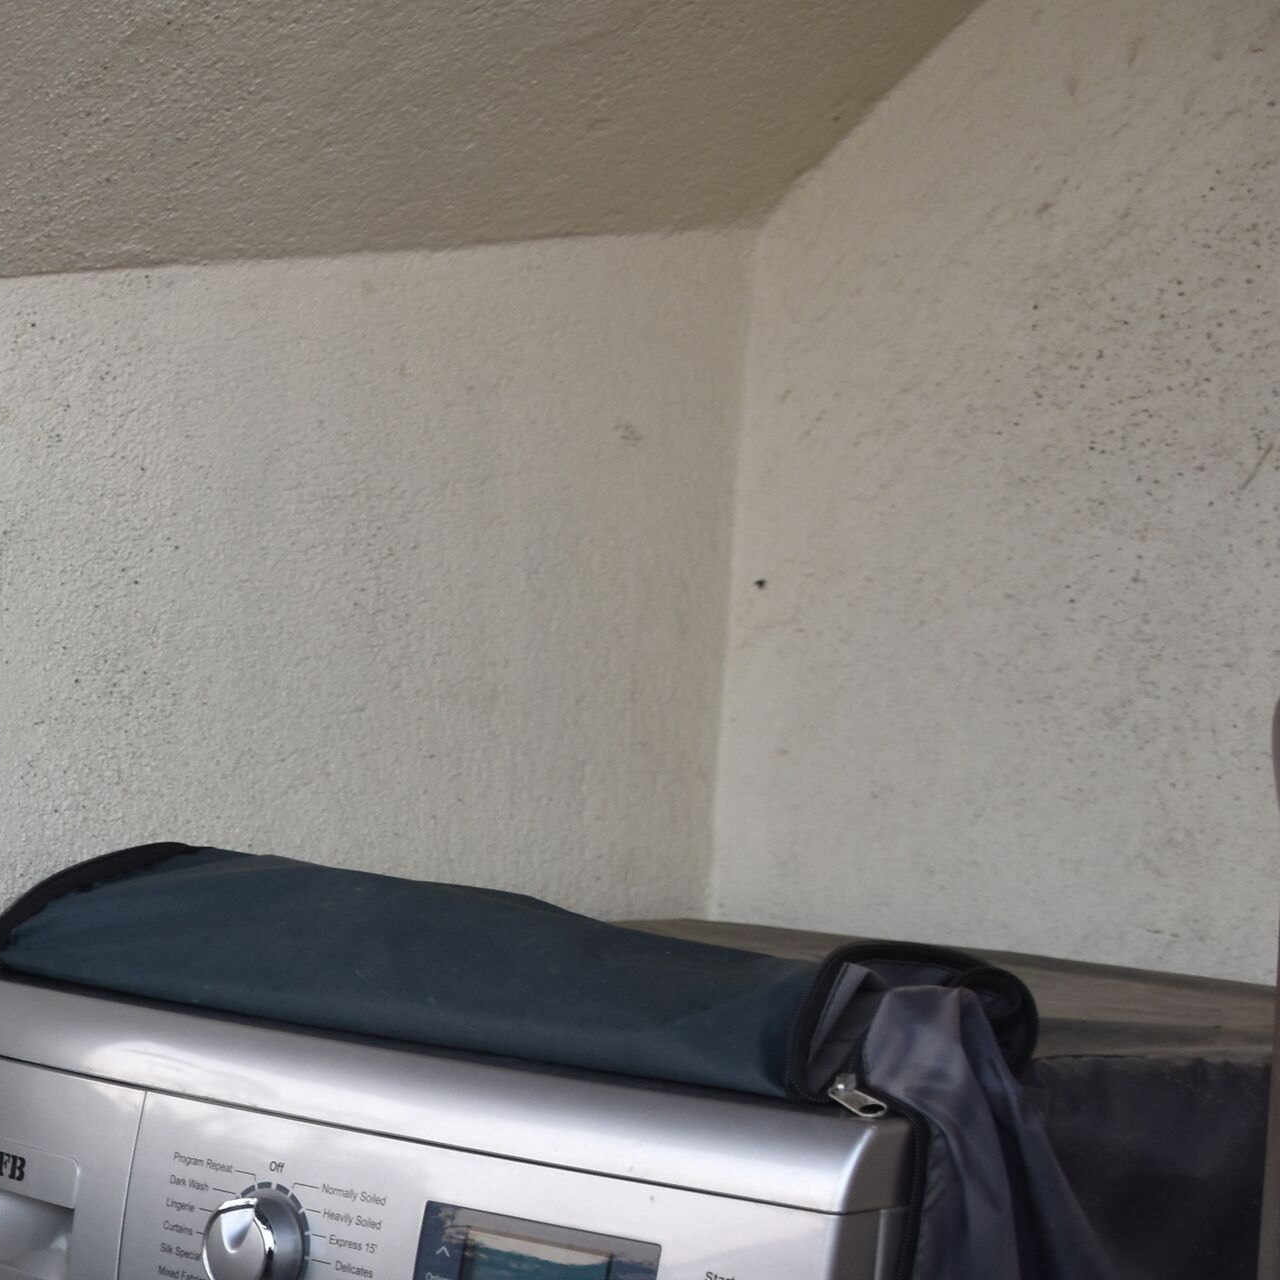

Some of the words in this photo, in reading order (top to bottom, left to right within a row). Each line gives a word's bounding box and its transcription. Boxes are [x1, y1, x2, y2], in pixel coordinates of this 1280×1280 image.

[173, 1152, 204, 1167] Program
[206, 1158, 234, 1174] Repeat
[269, 1160, 285, 1173] Off
[170, 1174, 186, 1186] Dark
[190, 1179, 209, 1192] Wash
[322, 1184, 358, 1202] Normally
[360, 1192, 386, 1206] Soiled
[166, 1198, 195, 1212] Lingerie
[322, 1208, 354, 1226] Heavily
[355, 1216, 382, 1230] Soiled
[163, 1220, 192, 1236] Curtains
[160, 1242, 173, 1254] Silk
[328, 1234, 362, 1251] Express
[158, 1265, 180, 1280] Mixed
[334, 1260, 374, 1278] Delicates
